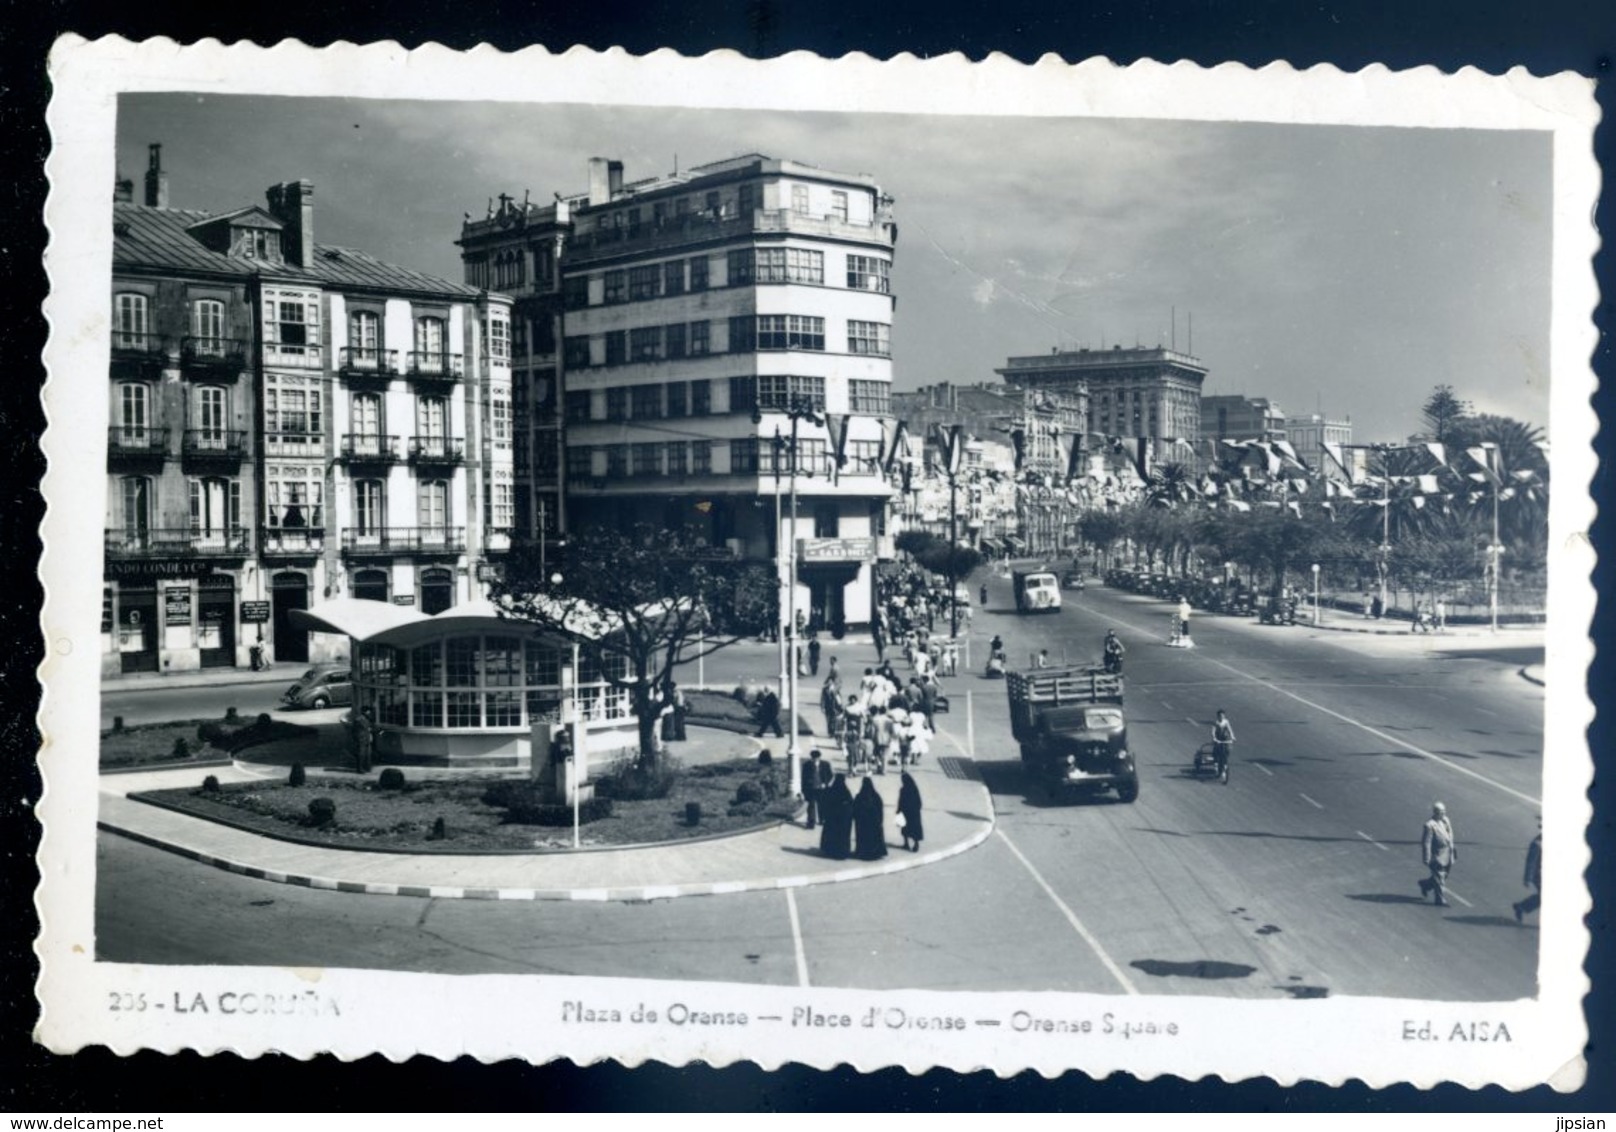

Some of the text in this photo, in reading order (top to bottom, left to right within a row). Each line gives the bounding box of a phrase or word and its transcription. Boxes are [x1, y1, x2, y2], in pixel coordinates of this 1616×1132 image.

[174, 992, 209, 1014] LA
[562, 1001, 622, 1023] Plaza
[630, 1003, 658, 1024] de
[791, 1005, 852, 1028] Place
[1010, 1010, 1092, 1033] Orense
[1402, 1020, 1512, 1042] Ed. AISA
